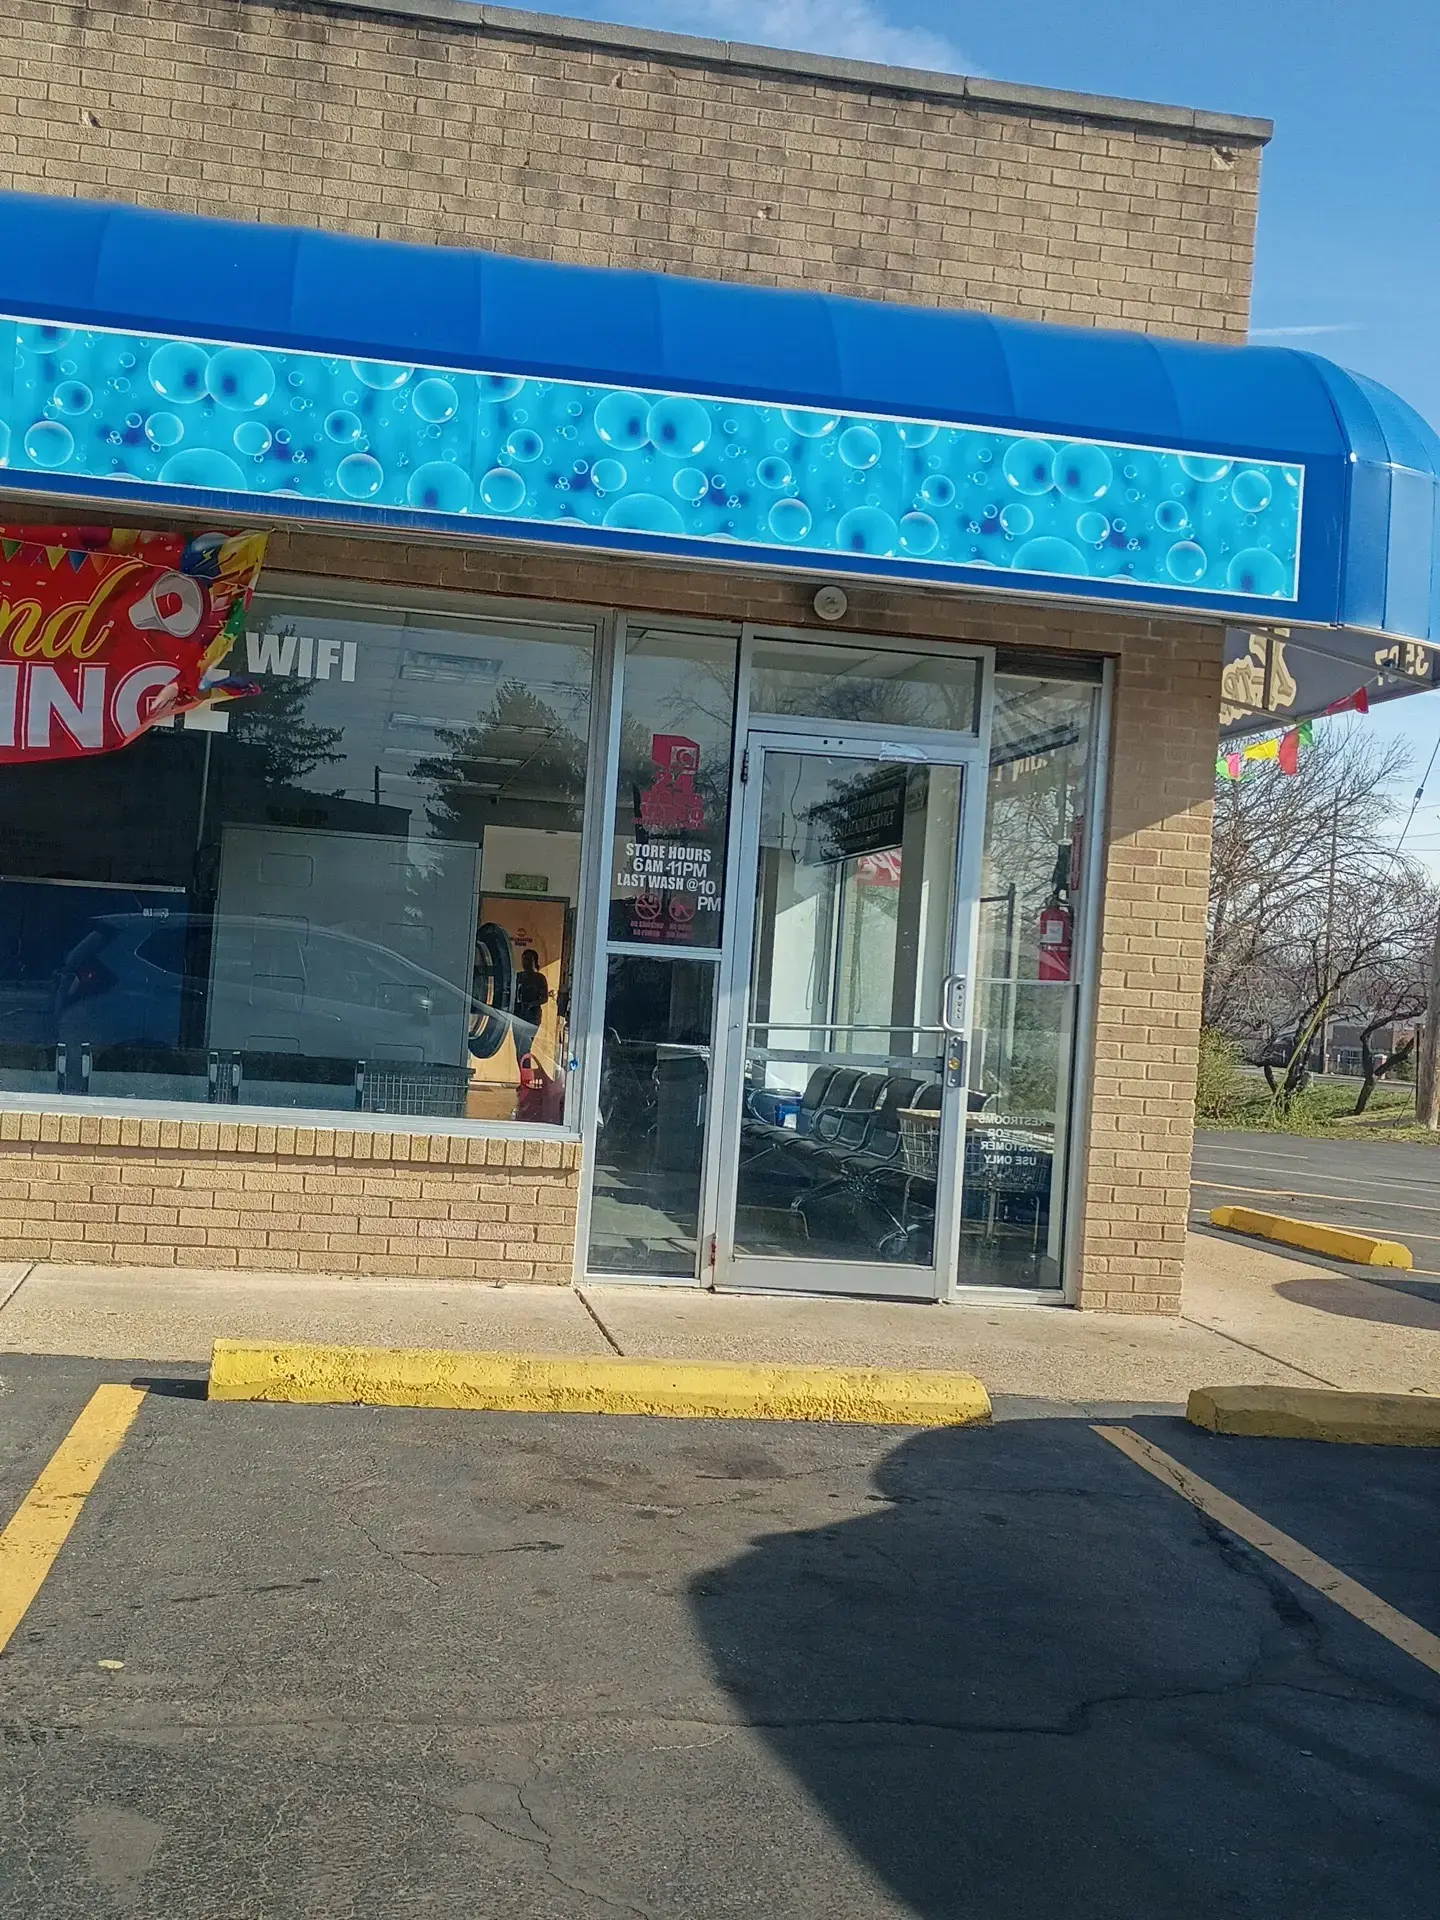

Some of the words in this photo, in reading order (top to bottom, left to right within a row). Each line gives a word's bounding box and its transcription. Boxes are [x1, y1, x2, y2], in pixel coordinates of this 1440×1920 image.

[246, 631, 358, 682] WIFI
[625, 842, 666, 859] STORE
[668, 846, 712, 862] HOURS
[617, 873, 647, 888] LAST
[648, 875, 684, 891] WASH
[697, 896, 721, 912] PM
